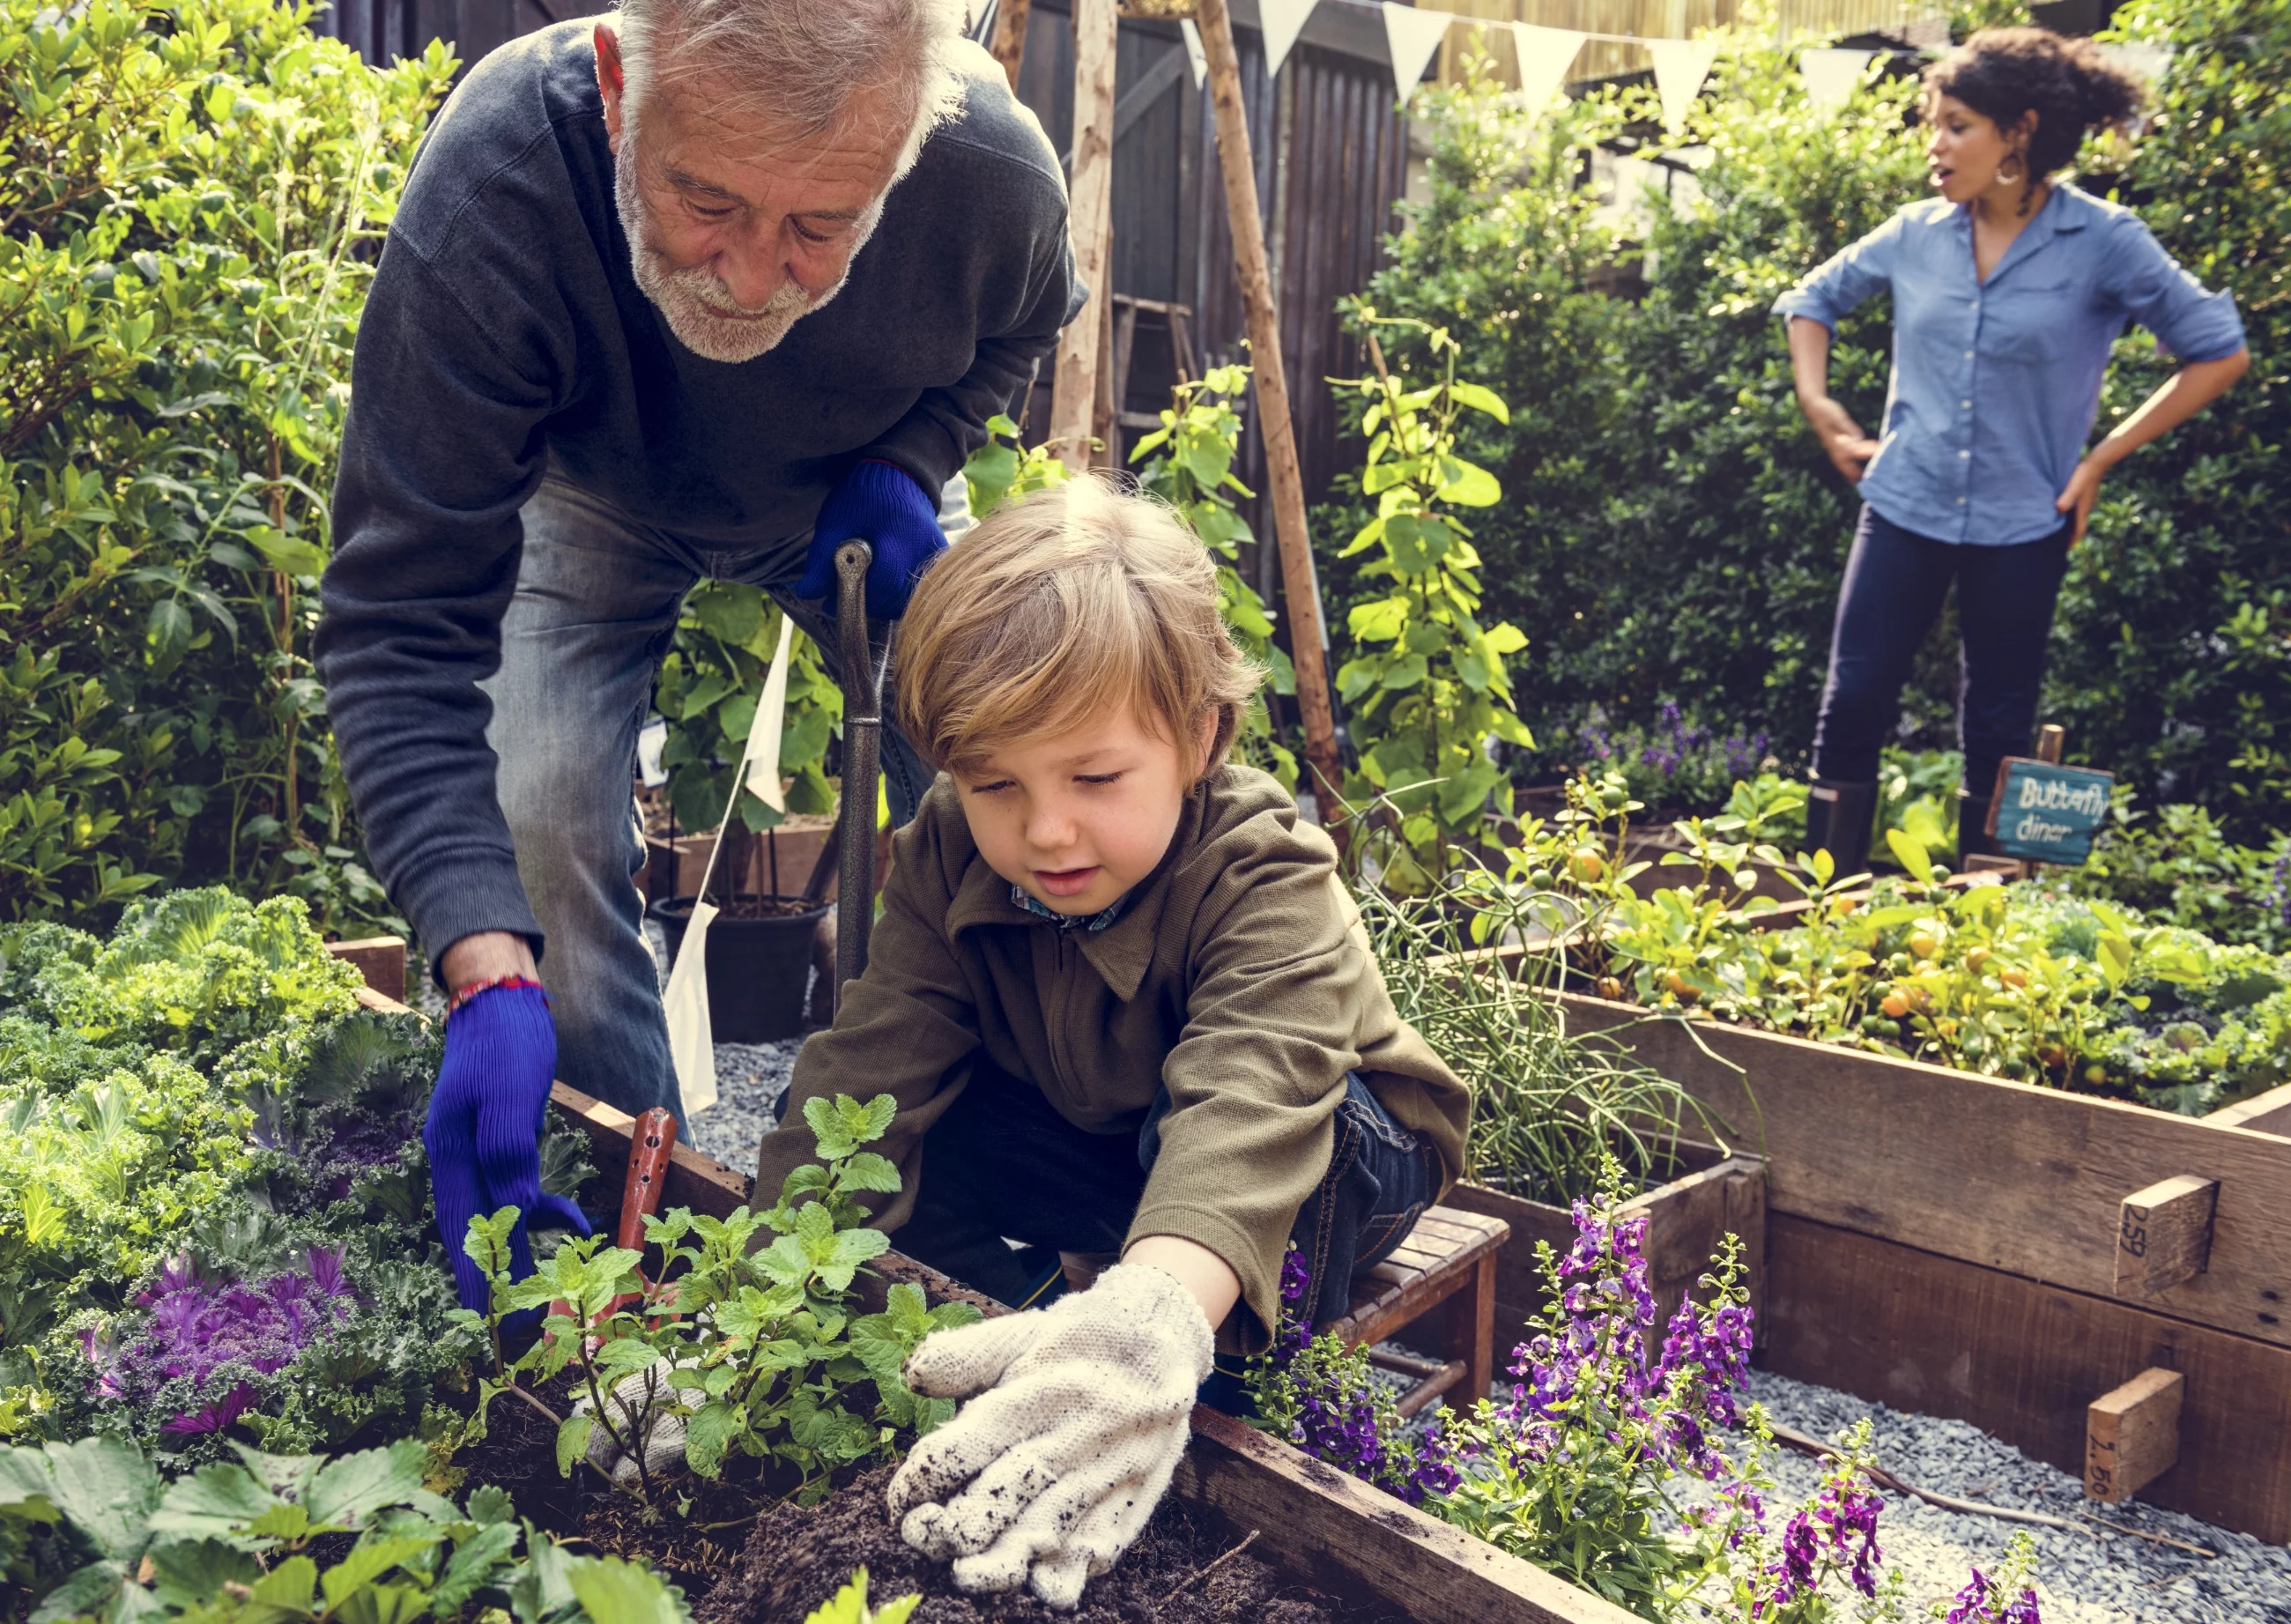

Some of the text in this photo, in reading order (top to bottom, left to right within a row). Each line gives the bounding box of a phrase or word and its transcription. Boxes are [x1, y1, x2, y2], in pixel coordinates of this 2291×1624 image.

[2015, 812, 2072, 842] diner
[2019, 776, 2109, 827] Butterfly
[2120, 1204, 2149, 1257] 2.59
